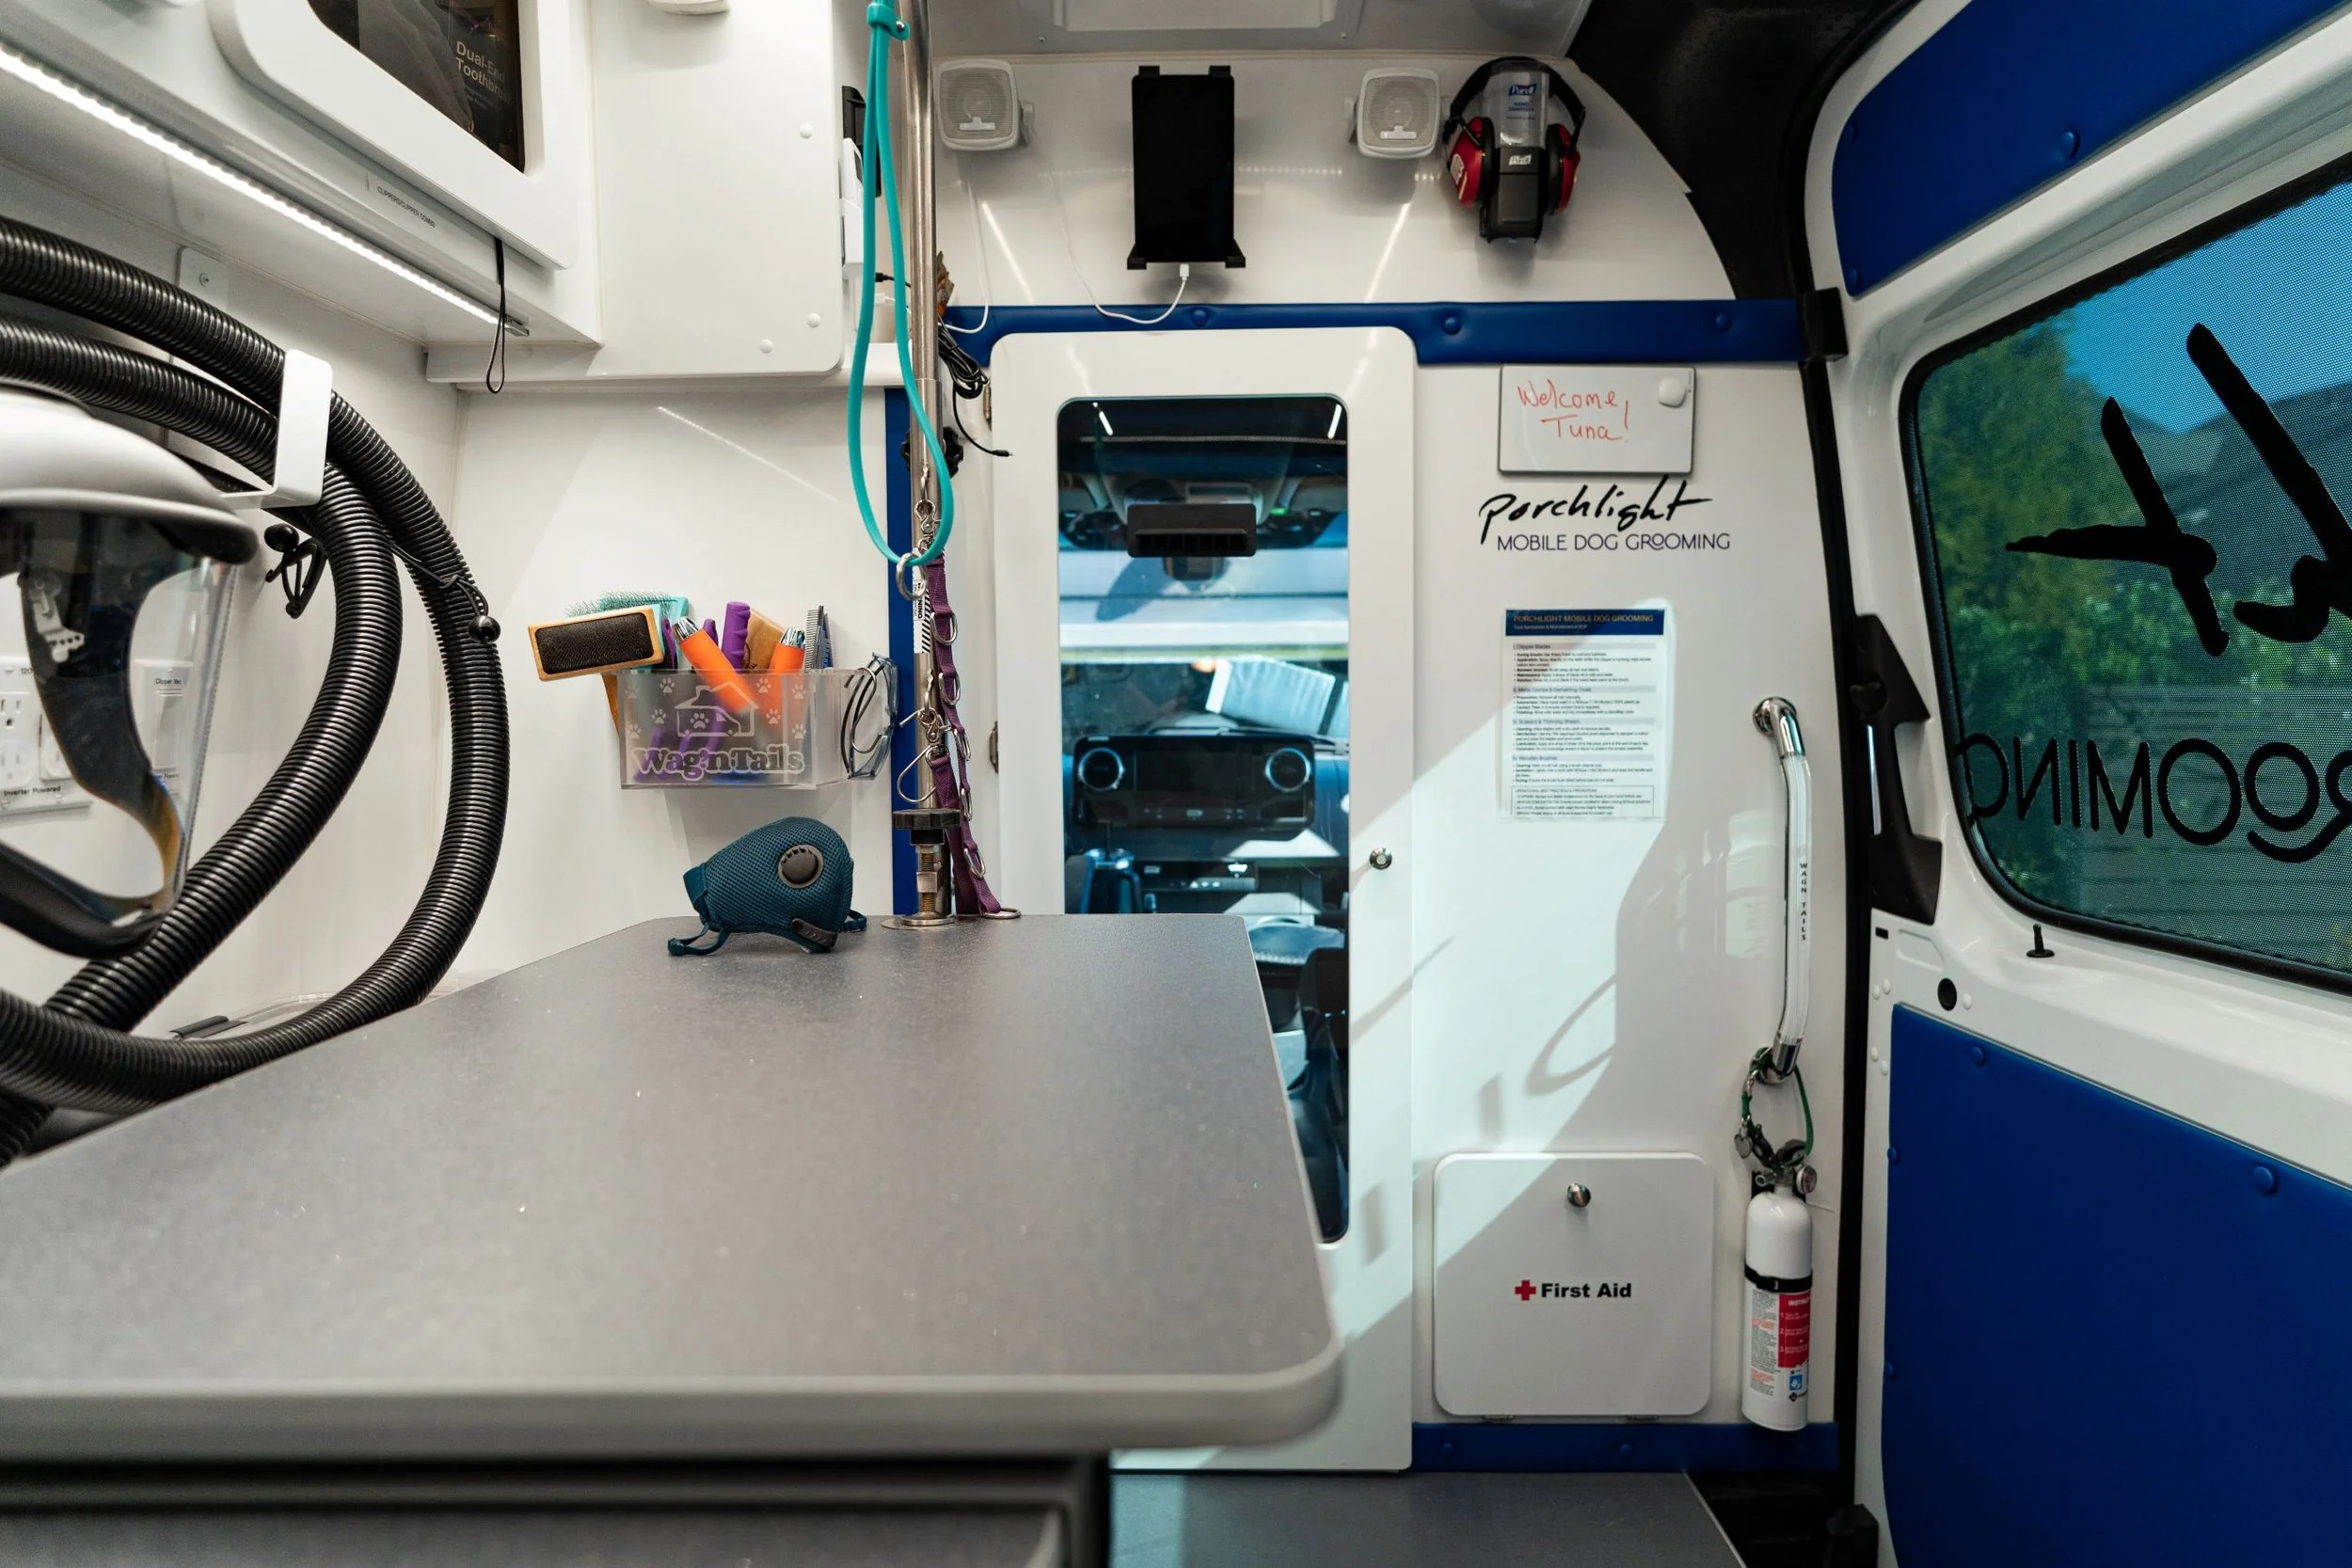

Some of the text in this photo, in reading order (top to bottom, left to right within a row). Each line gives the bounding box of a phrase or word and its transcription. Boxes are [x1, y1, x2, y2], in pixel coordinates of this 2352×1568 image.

[1517, 378, 1619, 410] Welcome
[1540, 400, 1630, 443] Tuna!
[1497, 532, 1731, 551] MOBILE DOG GROOMING
[1513, 614, 1654, 623] PORCHLIGHT MOBILE DOG GROOMING
[32, 785, 62, 795] Powered
[1541, 1282, 1632, 1298] First Aid
